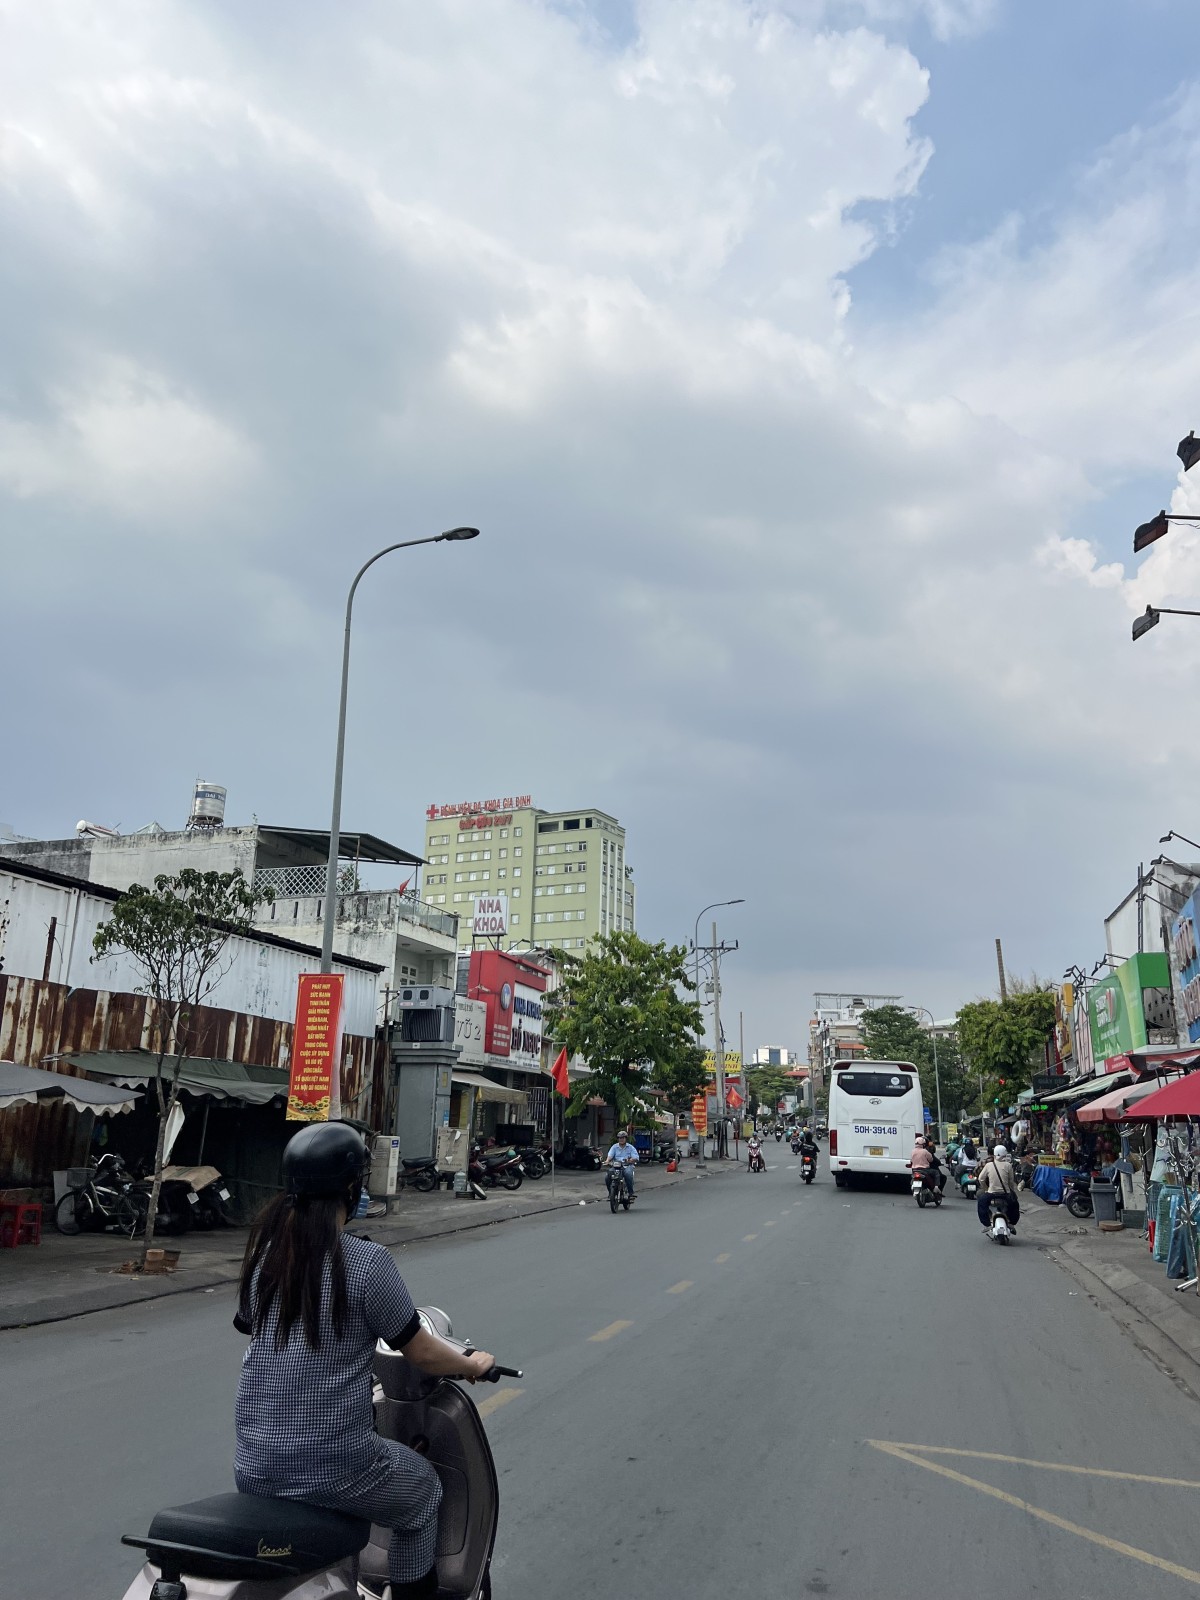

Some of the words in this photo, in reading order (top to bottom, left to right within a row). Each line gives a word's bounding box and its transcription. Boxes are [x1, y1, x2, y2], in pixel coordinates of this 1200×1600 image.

[484, 798, 501, 811] KHOA
[503, 797, 513, 808] GIA
[479, 900, 502, 913] NHA
[474, 917, 505, 931] KHOA
